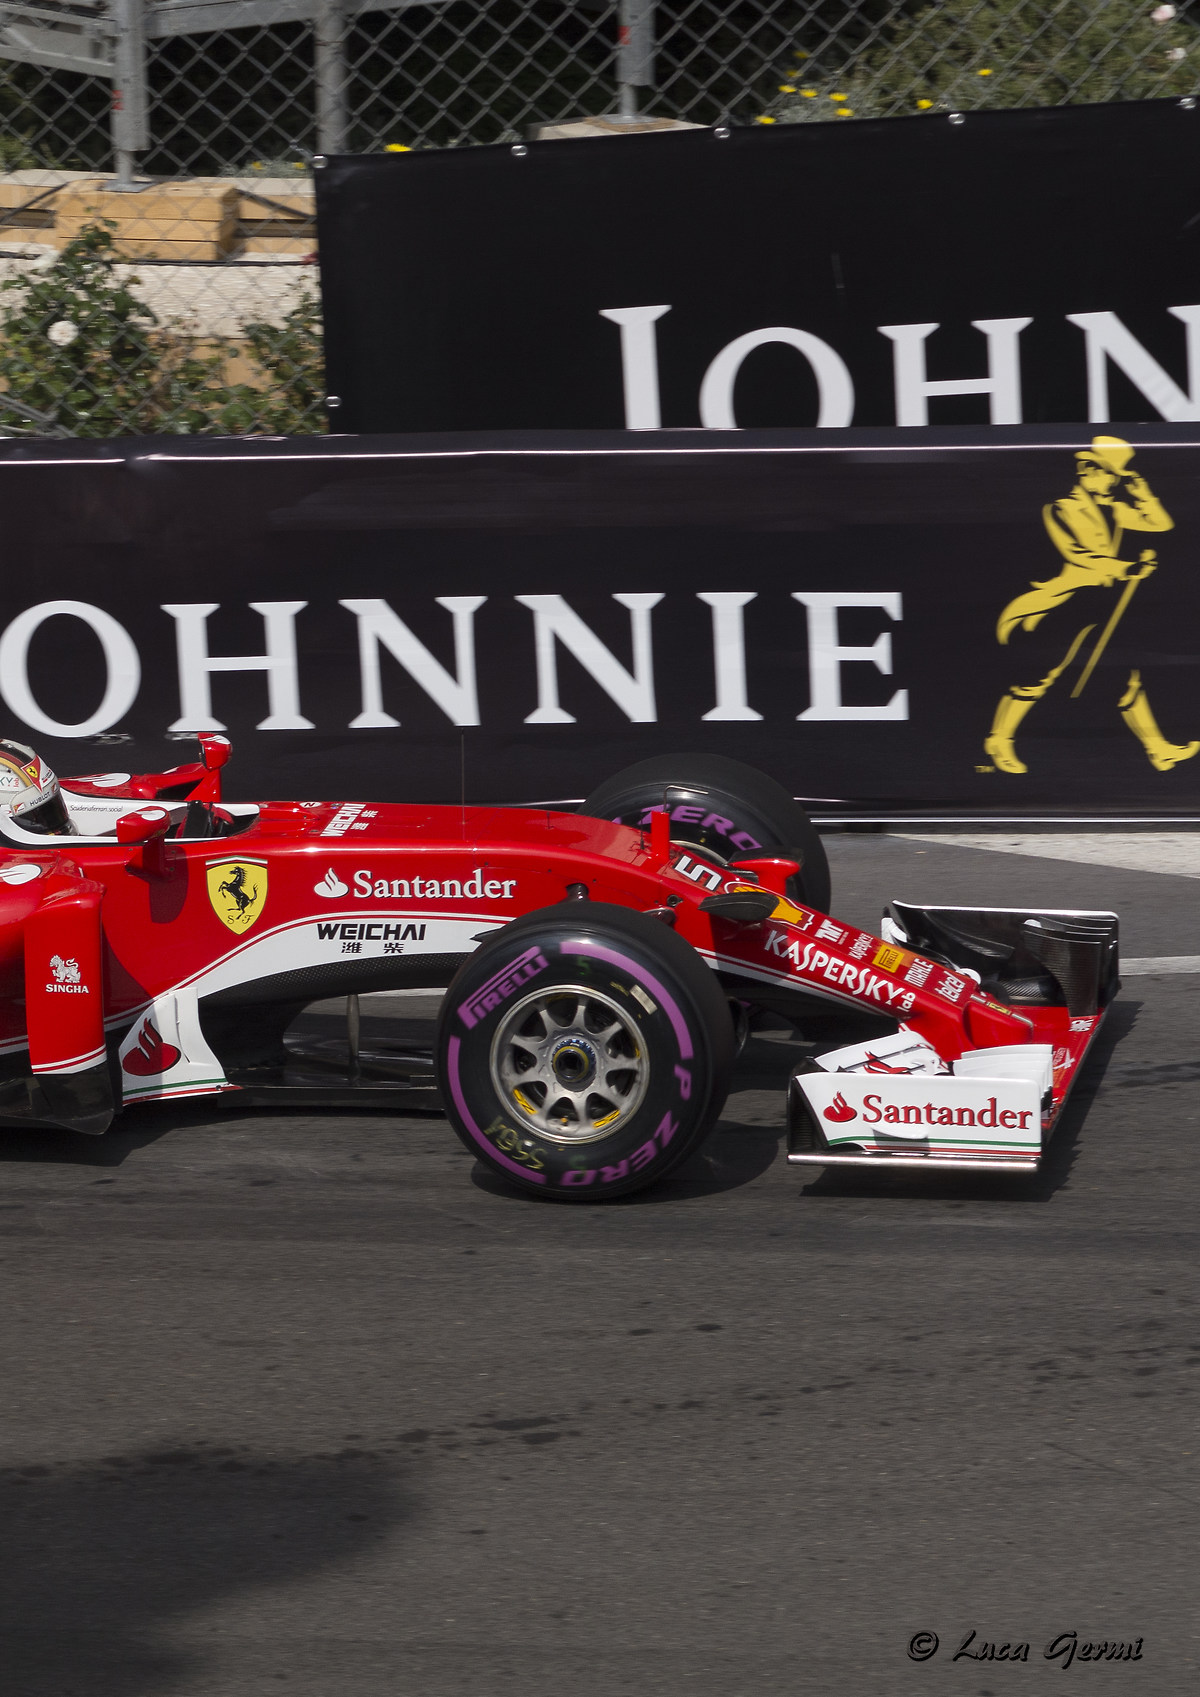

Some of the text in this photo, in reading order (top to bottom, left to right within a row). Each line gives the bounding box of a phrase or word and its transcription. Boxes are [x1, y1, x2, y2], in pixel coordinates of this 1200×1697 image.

[353, 868, 516, 899] Santander
[673, 855, 723, 891] 5
[317, 923, 426, 941] WEICHAI
[814, 919, 844, 942] TNT
[341, 941, 404, 953] 潍柴
[457, 945, 550, 1030] PIRELLI
[764, 930, 916, 1013] KASPERSKY lab
[904, 958, 934, 988] MAHLE
[934, 970, 966, 1003] telcel
[45, 983, 90, 994] SINGHA
[559, 1064, 692, 1186] P ZERO
[862, 1094, 1033, 1130] Santander
